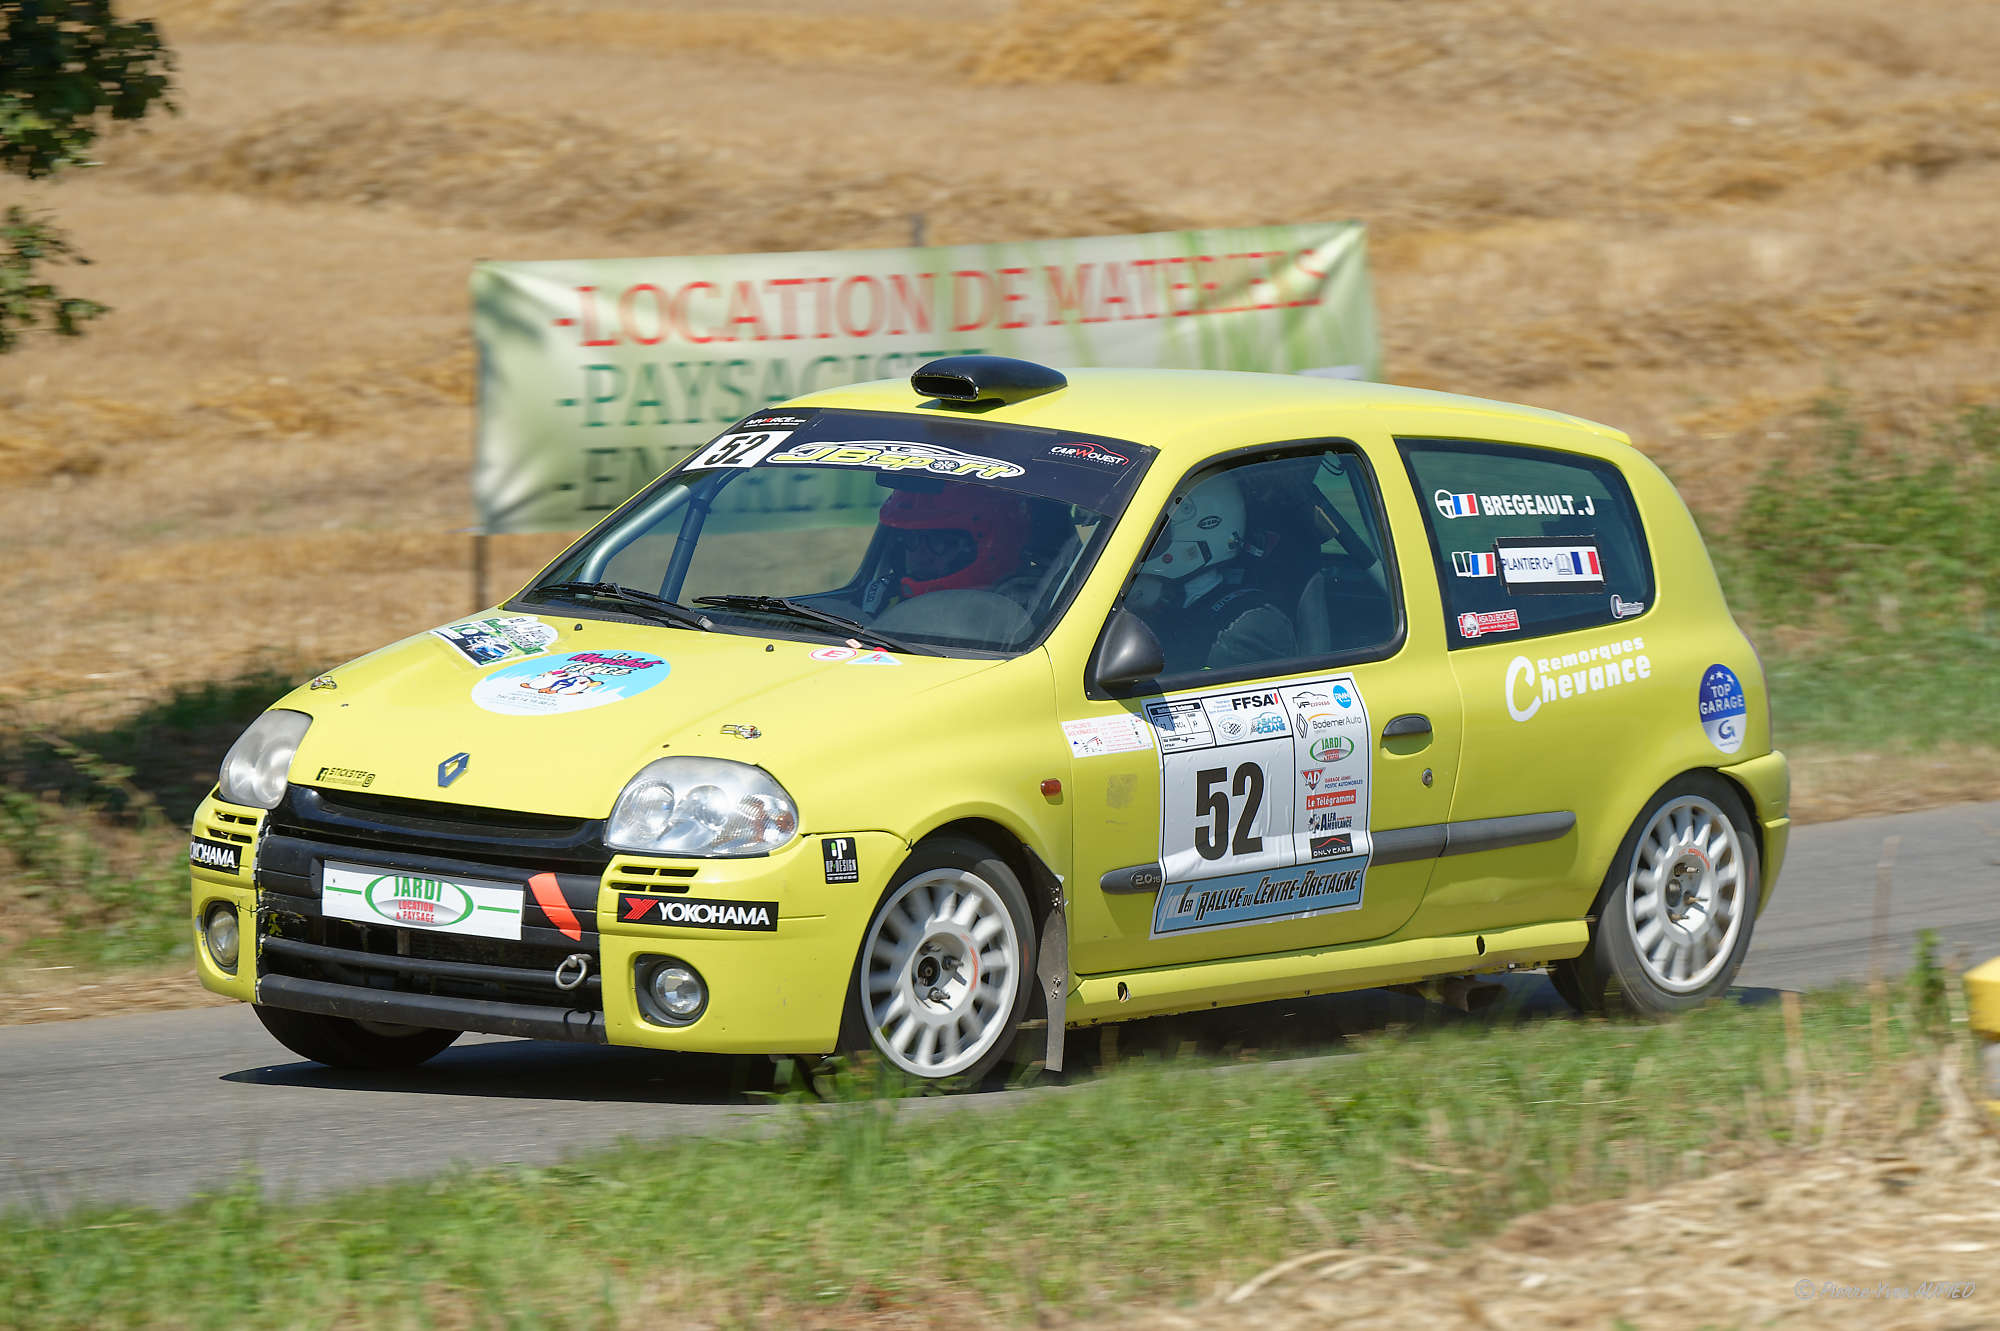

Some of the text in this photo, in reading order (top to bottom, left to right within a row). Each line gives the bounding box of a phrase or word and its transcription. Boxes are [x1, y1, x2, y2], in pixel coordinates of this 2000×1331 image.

[949, 267, 1028, 332] DE
[703, 433, 770, 465] 52
[1500, 557, 1542, 571] PLANTIER
[1537, 637, 1645, 674] Remorques
[1505, 655, 1651, 723] Chevance
[1710, 683, 1732, 698] TOP
[1231, 694, 1276, 711] FFSA
[1700, 694, 1745, 715] GARAGE
[1321, 736, 1342, 751] JARDI
[1305, 771, 1320, 787] AD
[1307, 795, 1355, 808] Le Télégramme
[1194, 762, 1265, 861] 52
[1313, 845, 1351, 857] ONLY CARS
[394, 876, 443, 902] JARDI
[397, 900, 434, 913] LOCATION
[1195, 887, 1246, 921] RALLYE
[403, 911, 435, 924] PAYSAGE
[658, 902, 771, 926] YOKOHAMA
